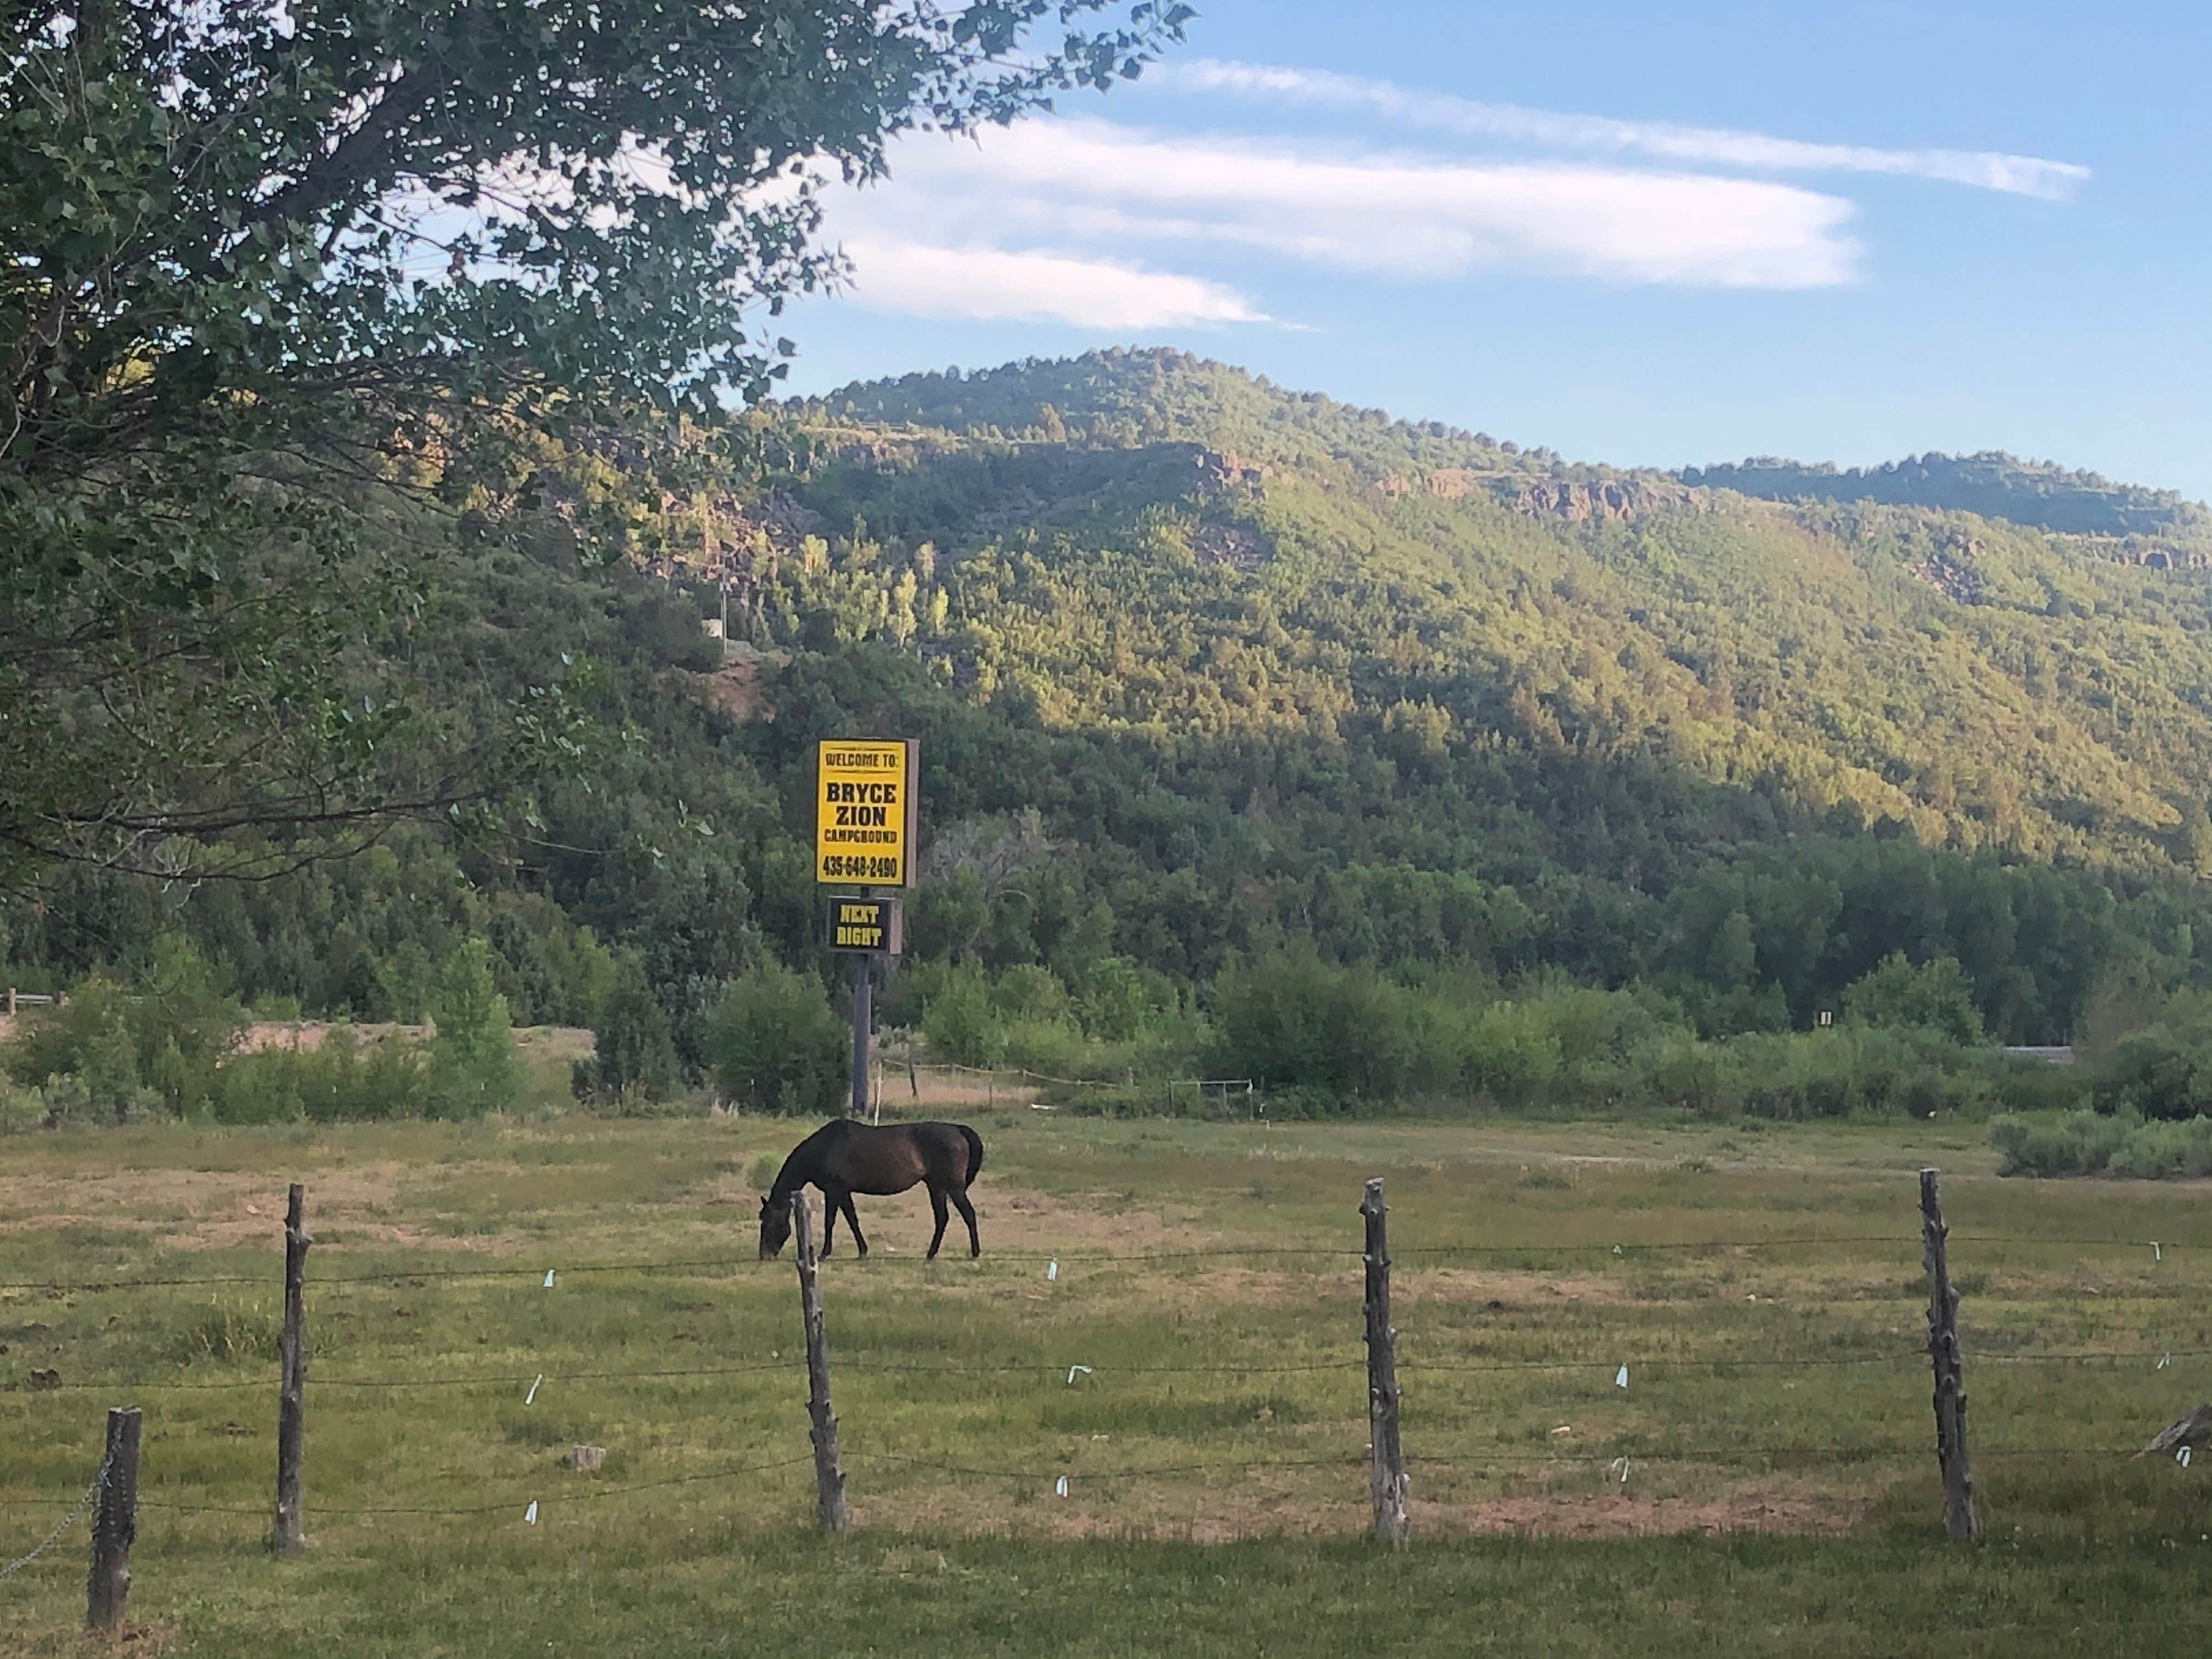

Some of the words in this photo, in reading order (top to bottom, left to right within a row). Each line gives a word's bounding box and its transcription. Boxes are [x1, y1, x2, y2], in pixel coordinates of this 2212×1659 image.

[826, 753, 879, 767] WELCOME
[826, 782, 896, 803] BRYCE
[836, 806, 886, 826] ZION
[825, 829, 897, 843] CAMPGROUND
[840, 905, 879, 923] NEXT
[836, 926, 882, 946] RIGHT
